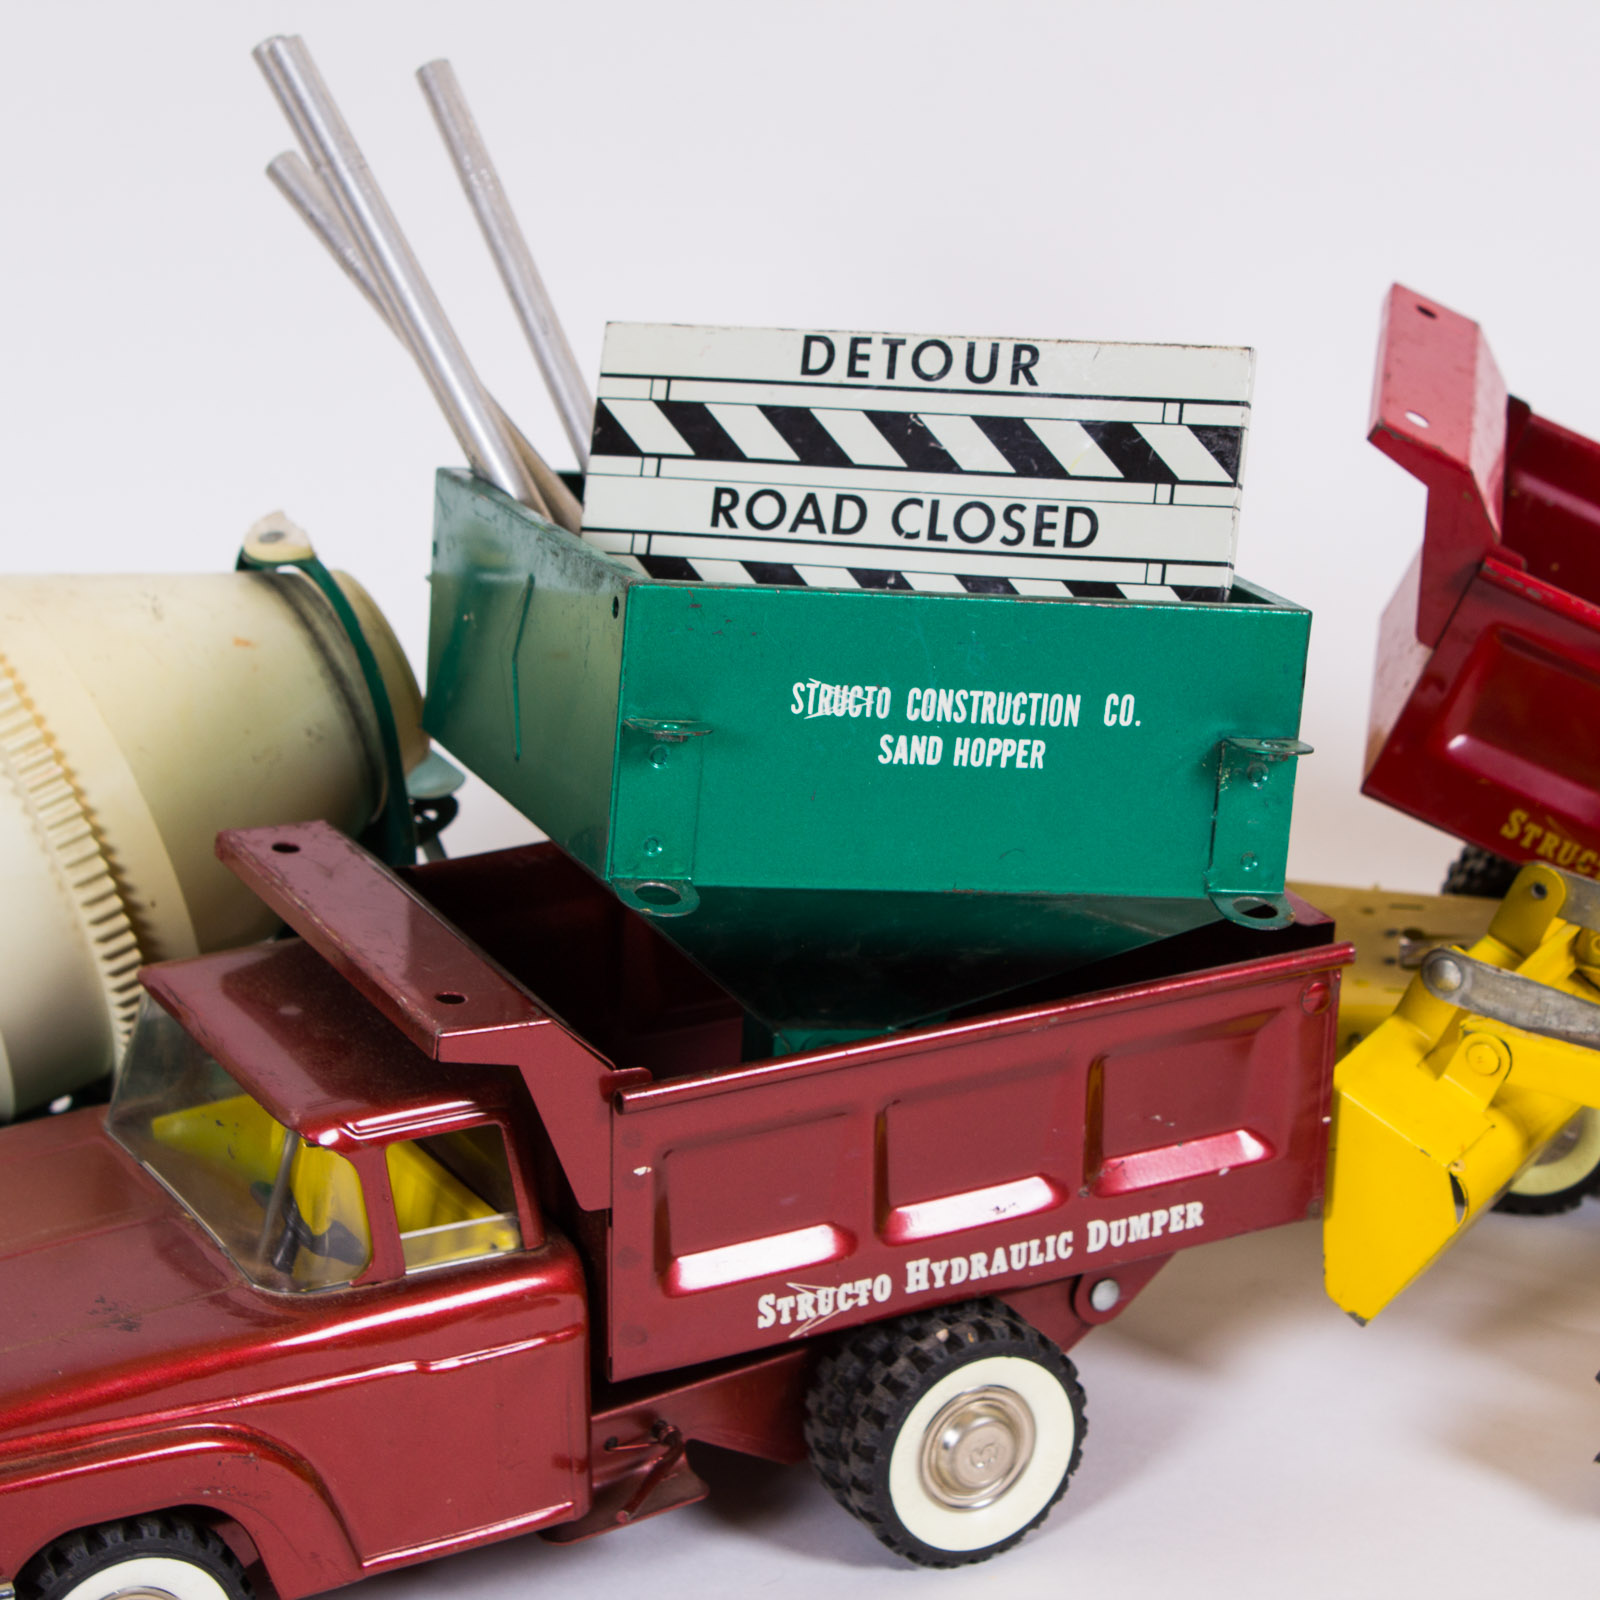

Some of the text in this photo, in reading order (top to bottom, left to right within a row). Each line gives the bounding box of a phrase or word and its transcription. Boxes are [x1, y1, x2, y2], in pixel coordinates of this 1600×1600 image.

[800, 334, 1040, 386] DETOUR
[710, 487, 1099, 549] ROAD CLOSED
[790, 679, 1141, 727] STRUCTO CONSTRUCTION CO.
[877, 734, 1046, 769] SAND HOPPER
[757, 1201, 1205, 1331] STRUCTO HYDRAULIC DUMPER
